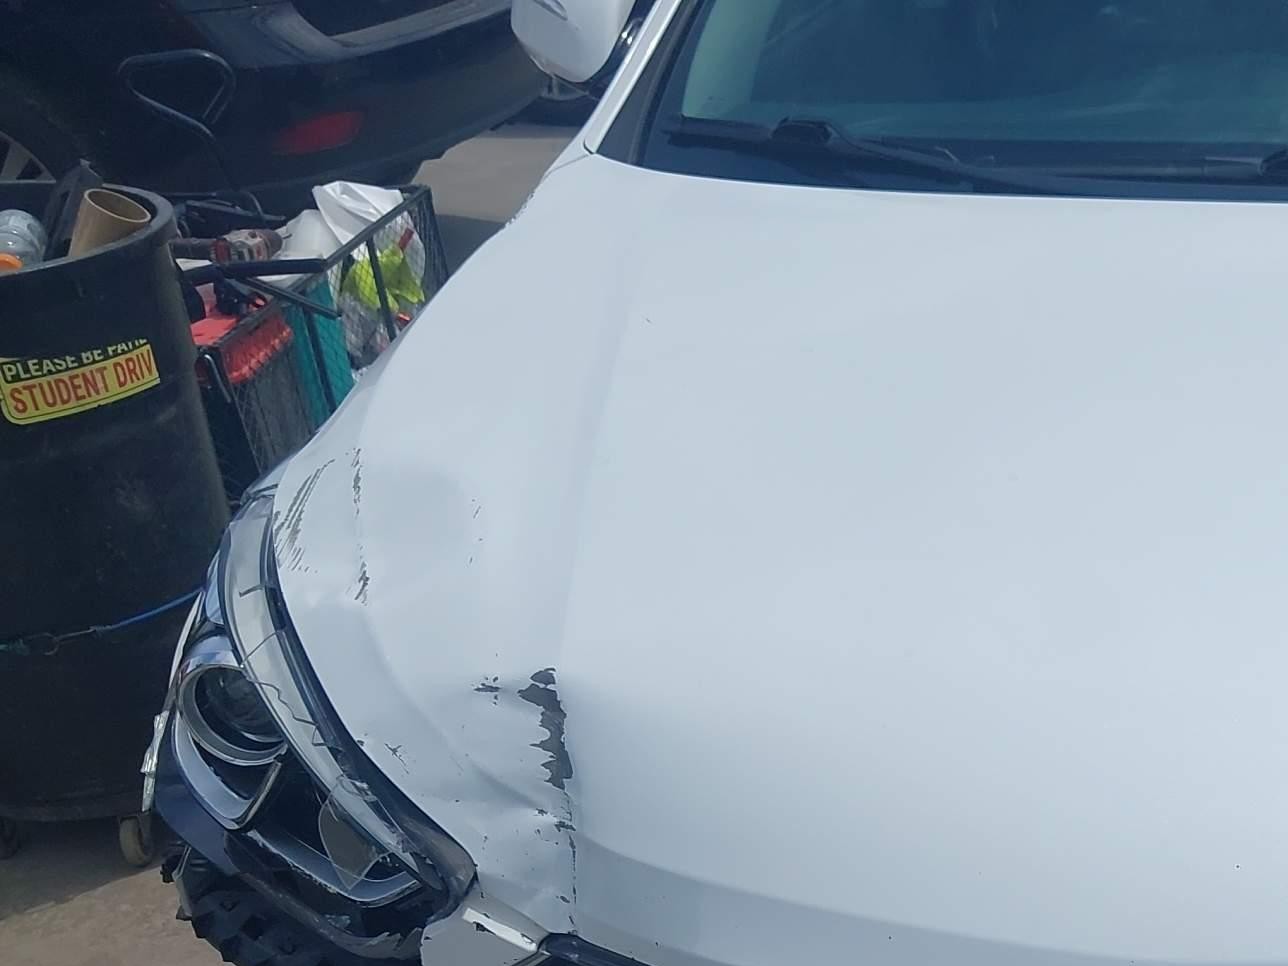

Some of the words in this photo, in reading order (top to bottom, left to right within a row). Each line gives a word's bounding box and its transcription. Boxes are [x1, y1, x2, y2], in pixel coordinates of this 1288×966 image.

[2, 356, 79, 382] PLEASE
[81, 349, 104, 364] BE
[10, 366, 109, 414] STUDENT
[113, 349, 154, 388] DRIV
